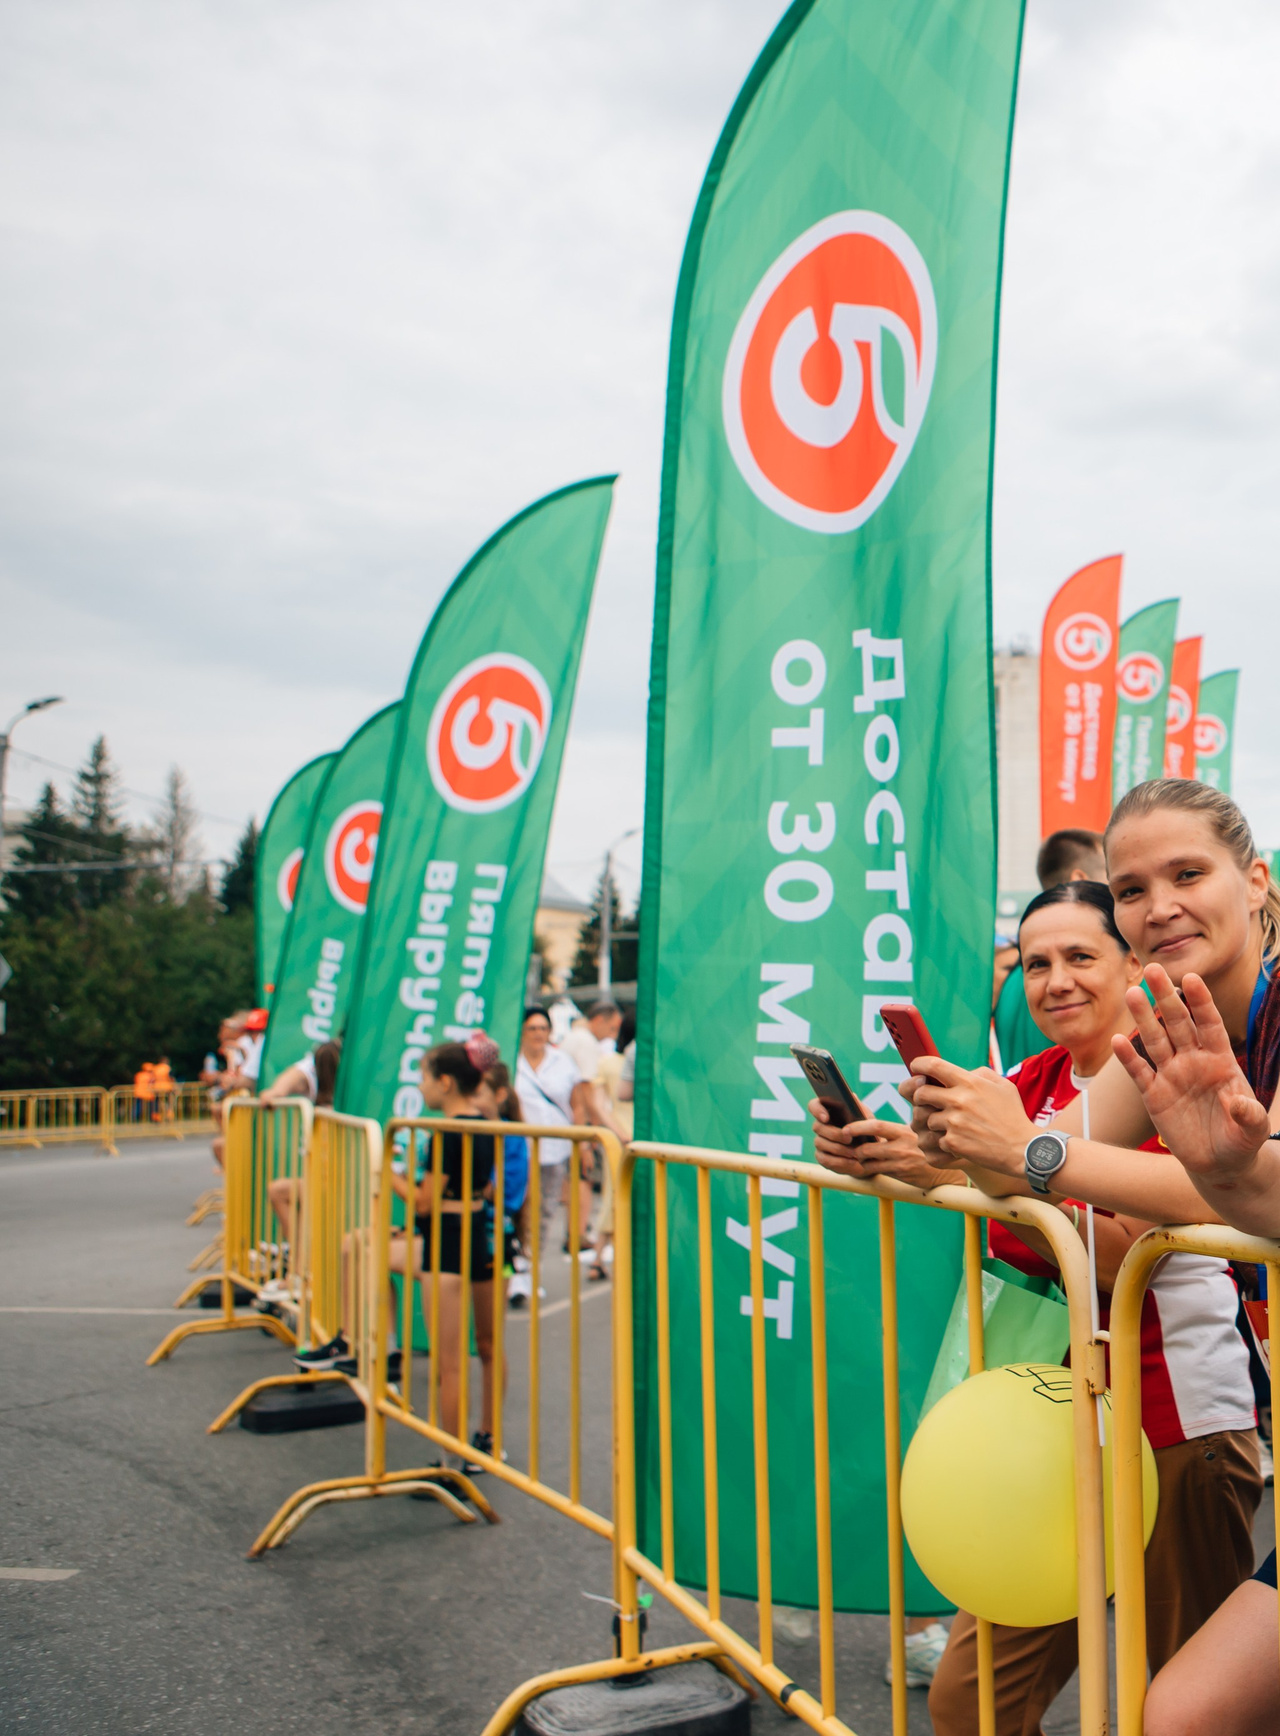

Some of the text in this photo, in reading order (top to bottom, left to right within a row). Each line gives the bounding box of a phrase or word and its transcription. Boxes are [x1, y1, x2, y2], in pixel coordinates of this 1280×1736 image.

[393, 860, 459, 1119] выручае
[726, 639, 836, 1340] от 30 минут
[852, 628, 912, 1125] Доставк
